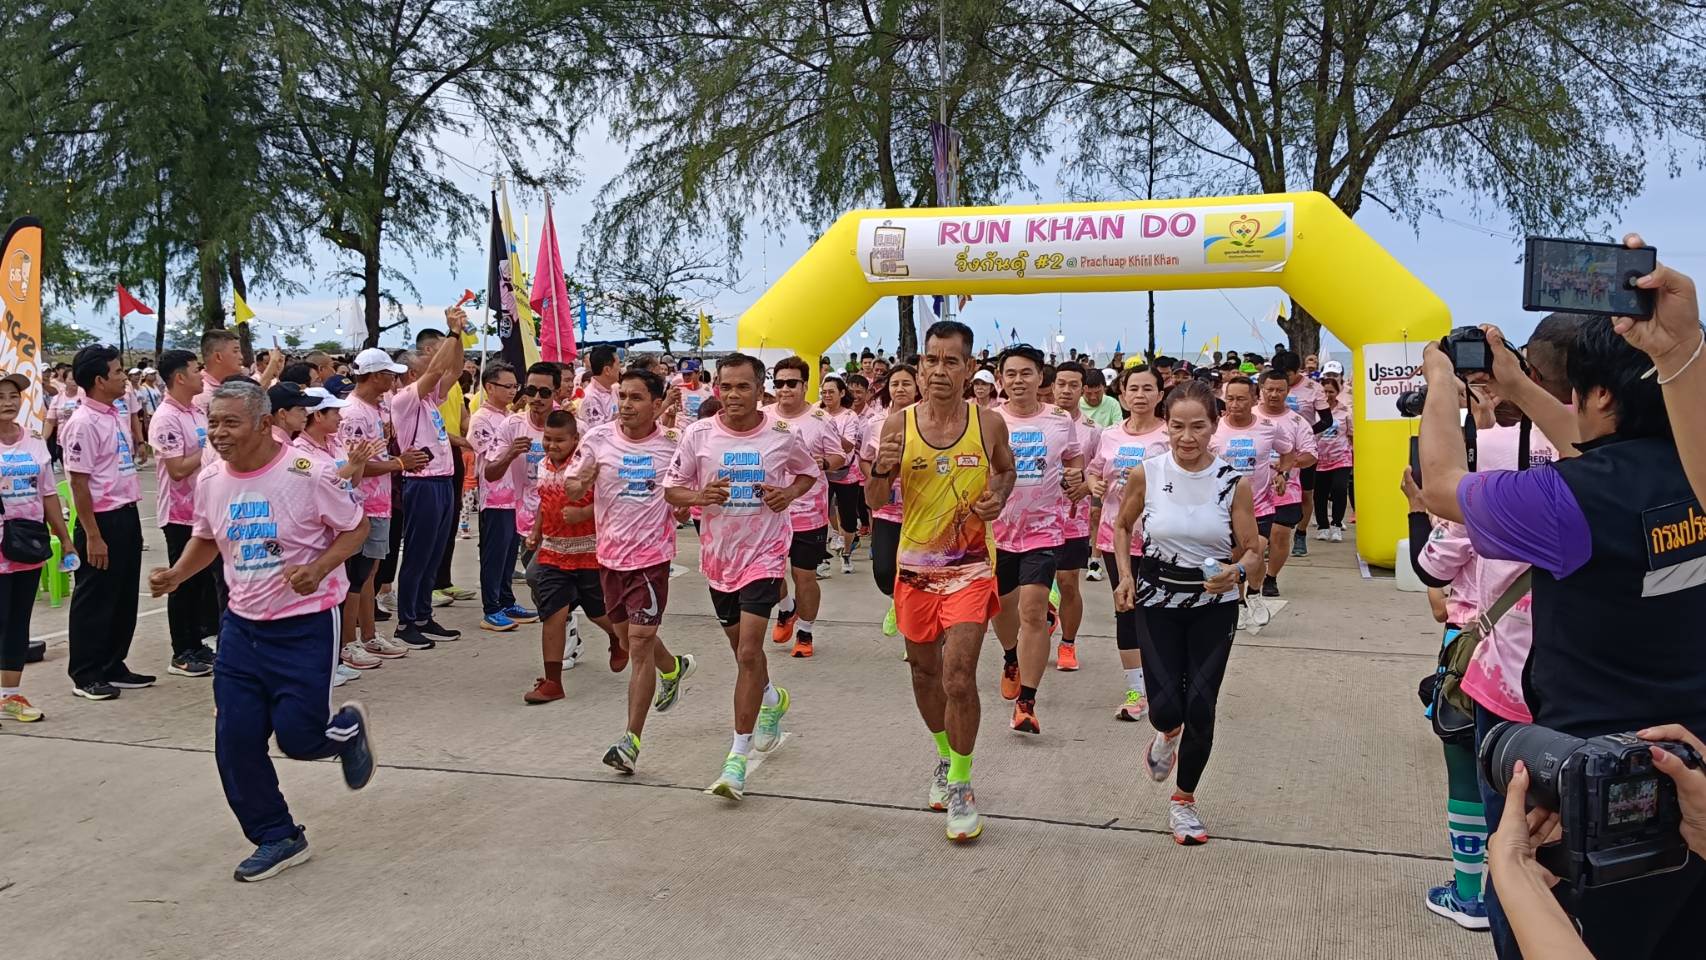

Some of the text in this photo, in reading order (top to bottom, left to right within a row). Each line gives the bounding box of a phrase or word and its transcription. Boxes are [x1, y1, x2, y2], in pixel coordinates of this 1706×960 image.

[938, 211, 1196, 246] RUN KHAN DO
[1034, 252, 1064, 270] #2
[1080, 255, 1126, 269] Prachuap
[1128, 254, 1151, 267] Khiri
[1153, 253, 1179, 266] Khan
[724, 452, 760, 466] RUN
[230, 500, 270, 520] RUN
